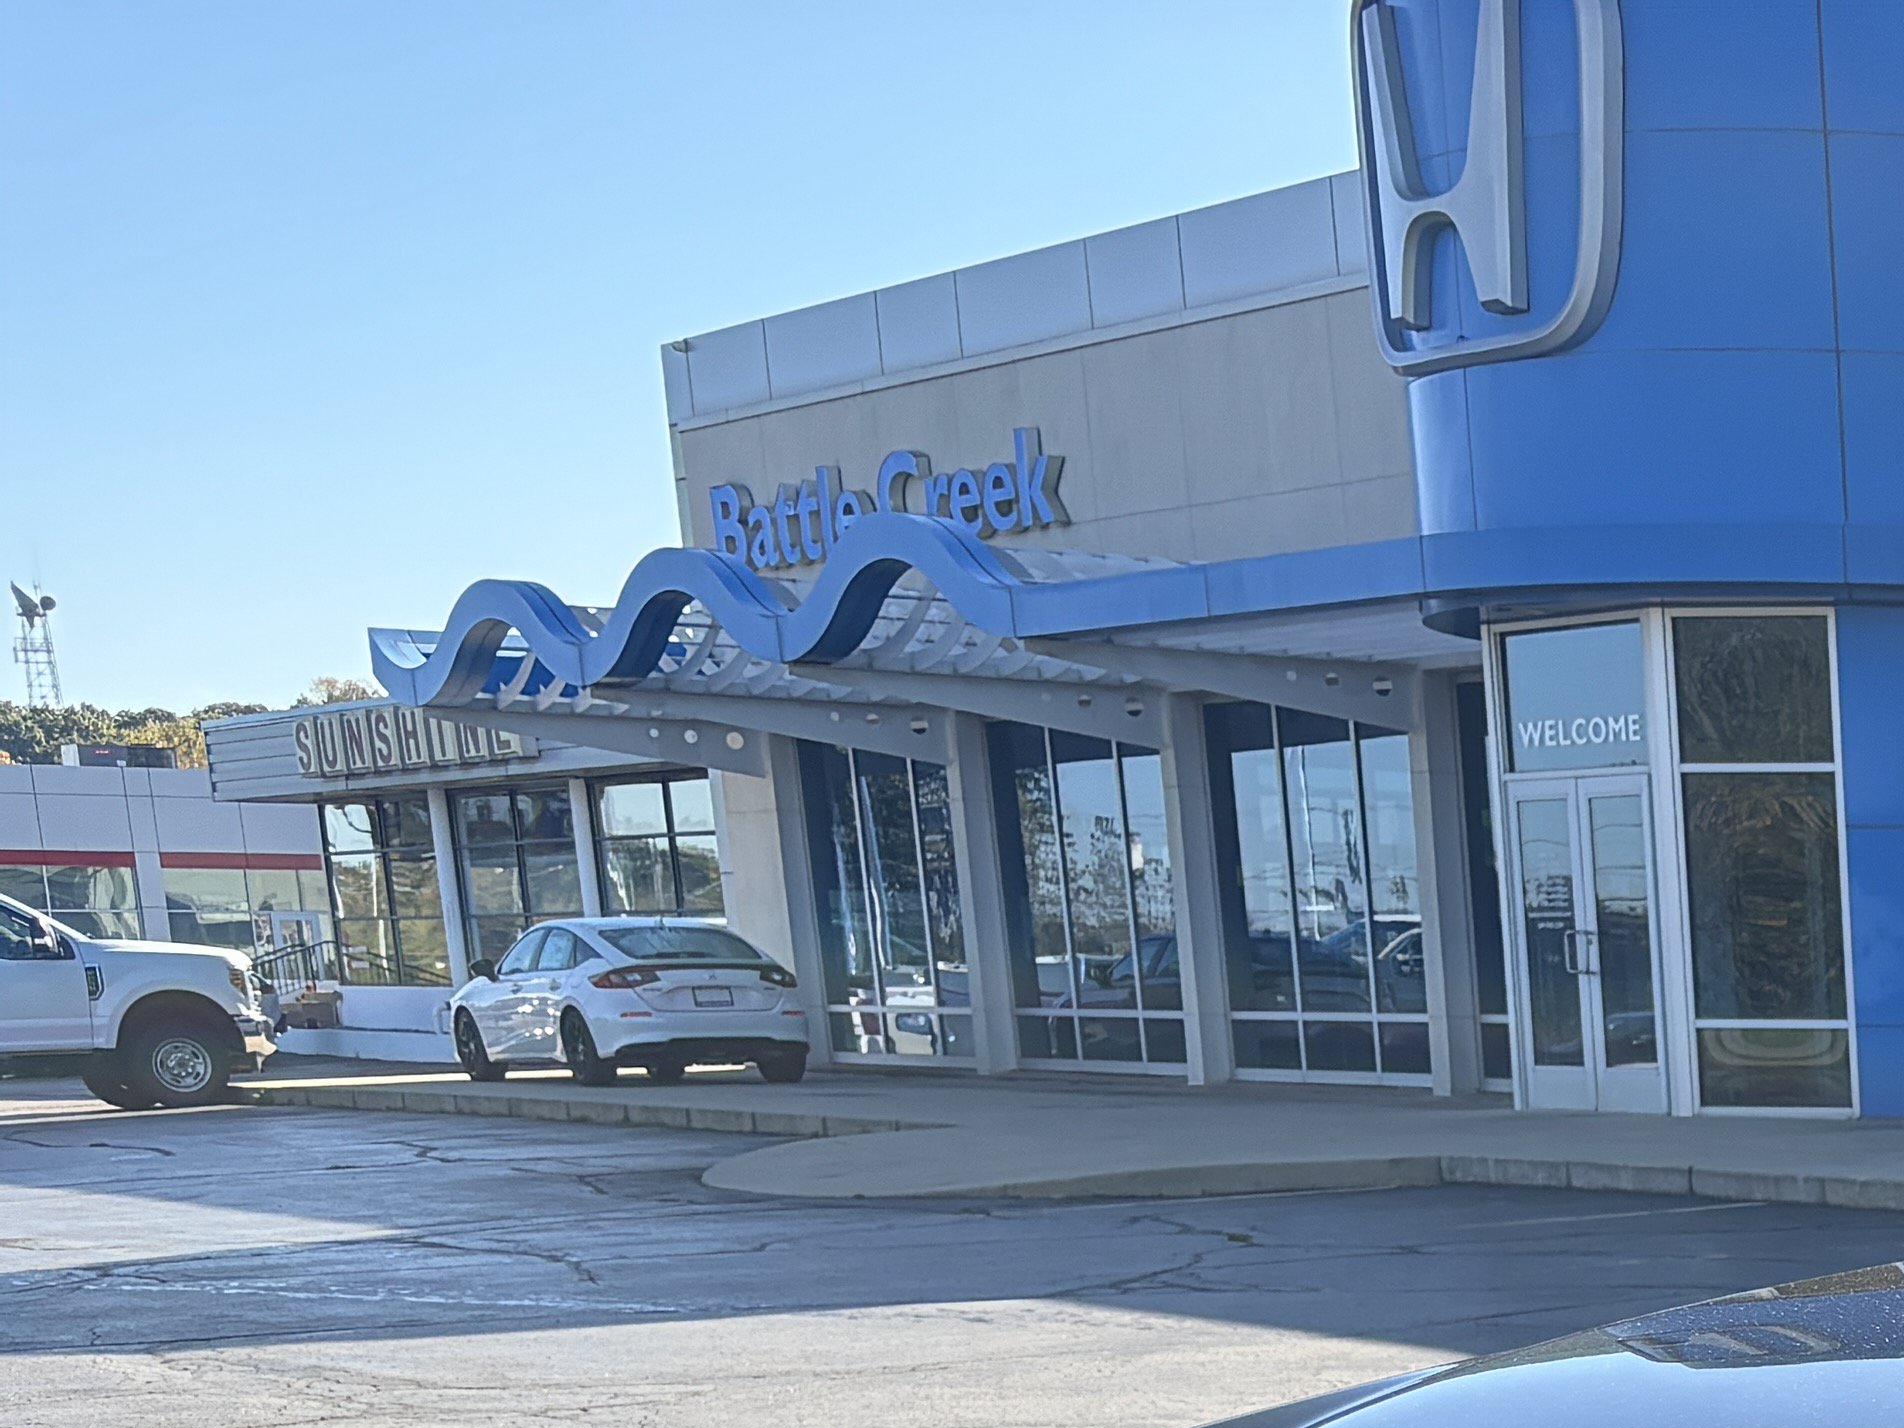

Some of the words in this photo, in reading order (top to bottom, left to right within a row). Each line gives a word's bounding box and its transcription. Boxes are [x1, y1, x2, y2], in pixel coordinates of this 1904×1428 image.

[710, 466, 868, 569] Battle
[877, 427, 1066, 535] Creek
[1518, 714, 1641, 748] WELCOME
